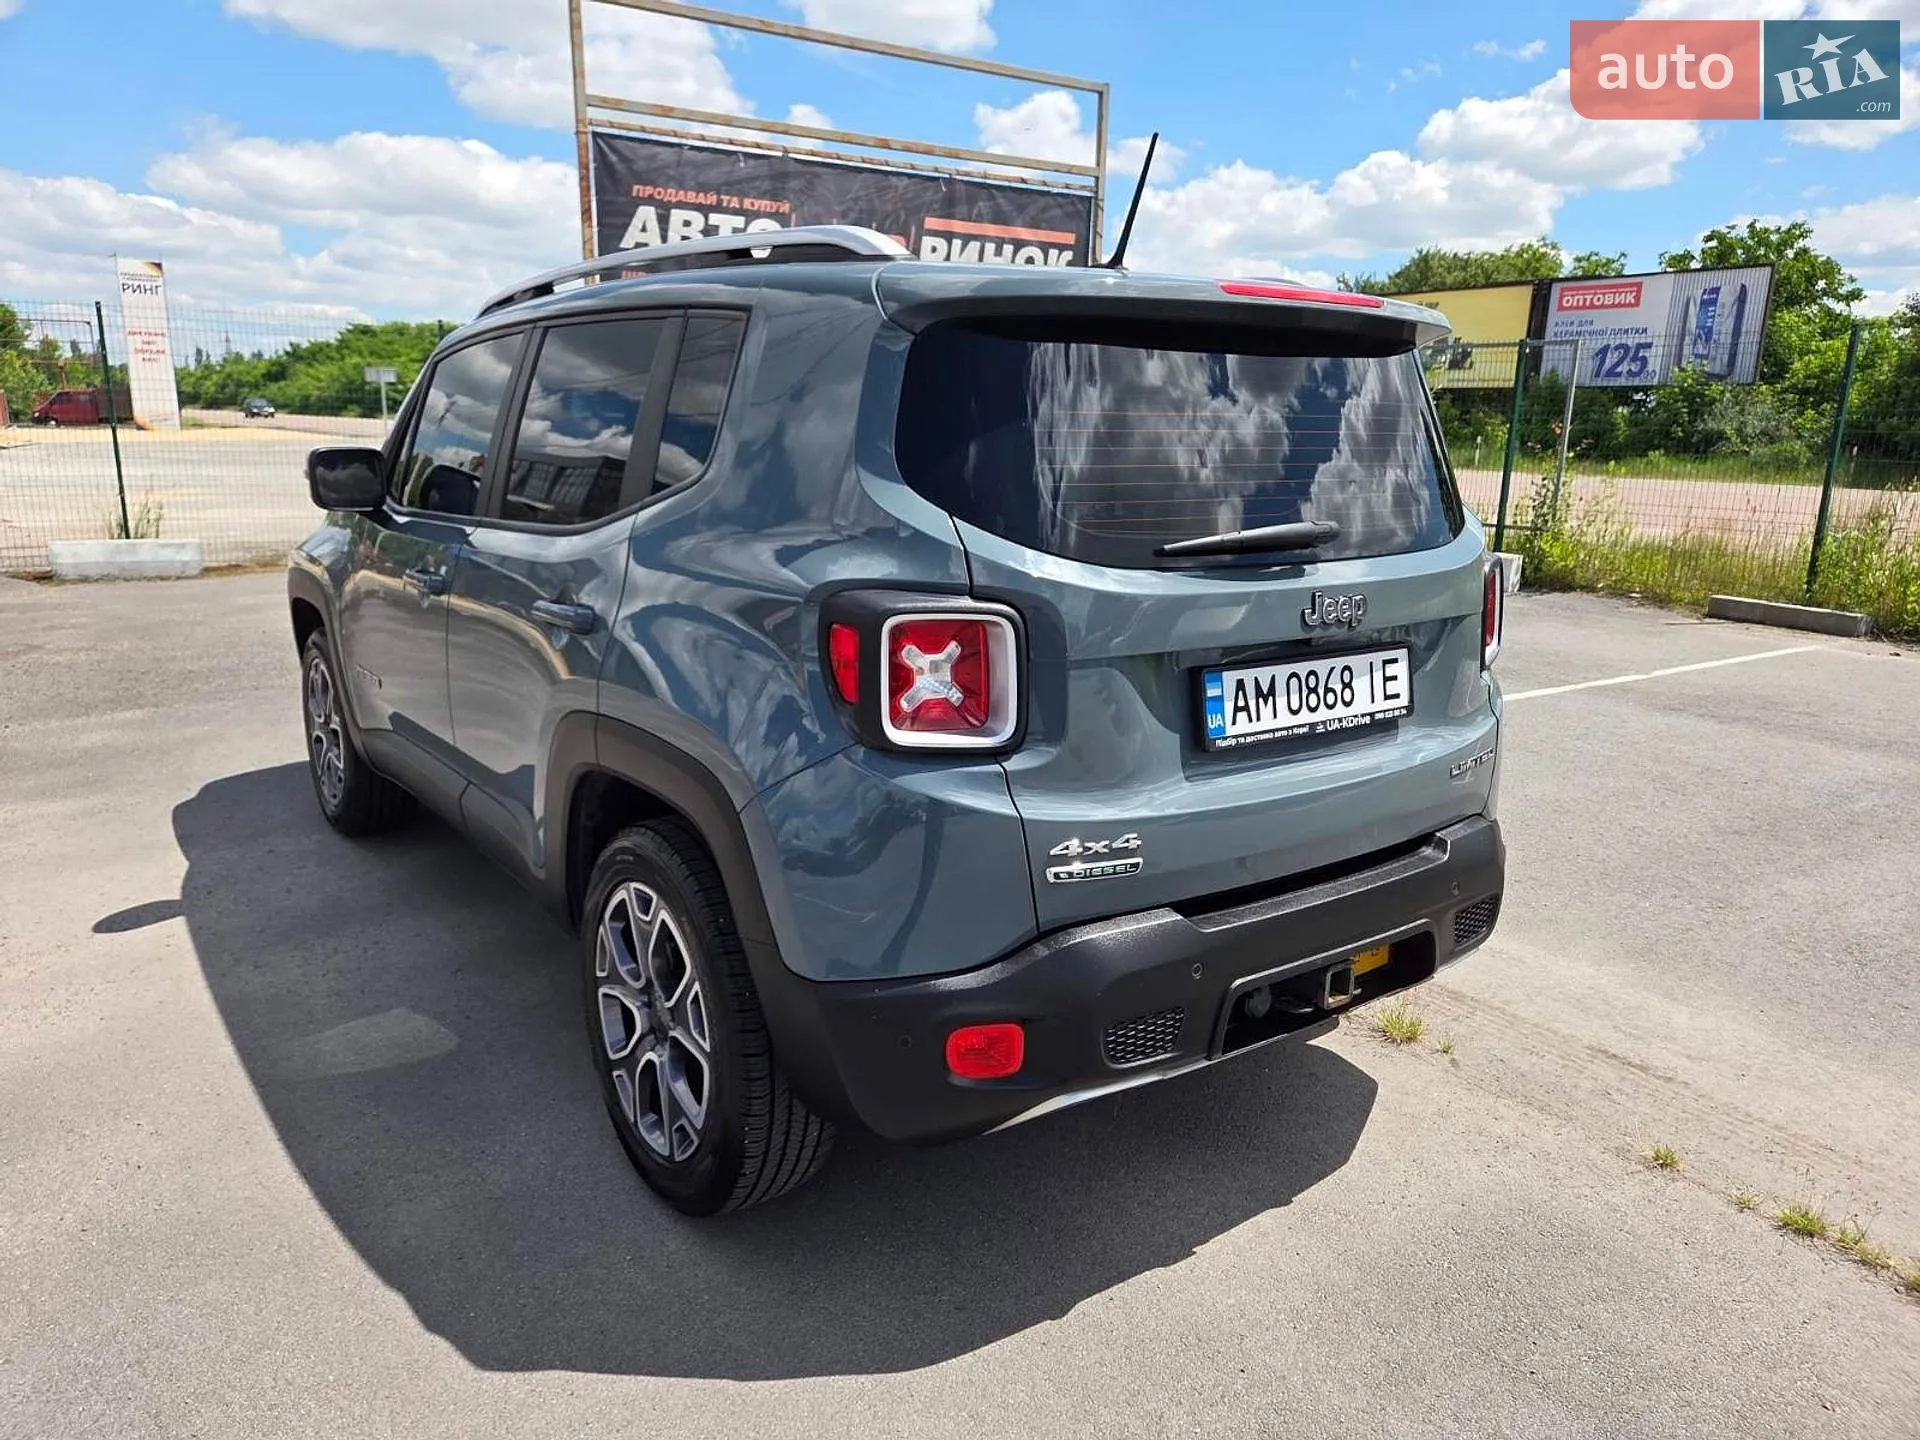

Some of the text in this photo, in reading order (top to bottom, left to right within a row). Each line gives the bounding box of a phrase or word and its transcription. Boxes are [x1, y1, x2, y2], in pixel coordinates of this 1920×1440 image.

[632, 184, 791, 214] ПРОДАВАЙ ТА КУПУЙ
[122, 283, 161, 296] РИНГ
[1562, 292, 1637, 308] ОПТОВИК
[1594, 342, 1654, 378] 125
[1304, 591, 1367, 627] Jeep
[1231, 657, 1401, 726] AM 0868 IE
[1208, 712, 1225, 729] UA
[1073, 864, 1137, 879] DIESEL
